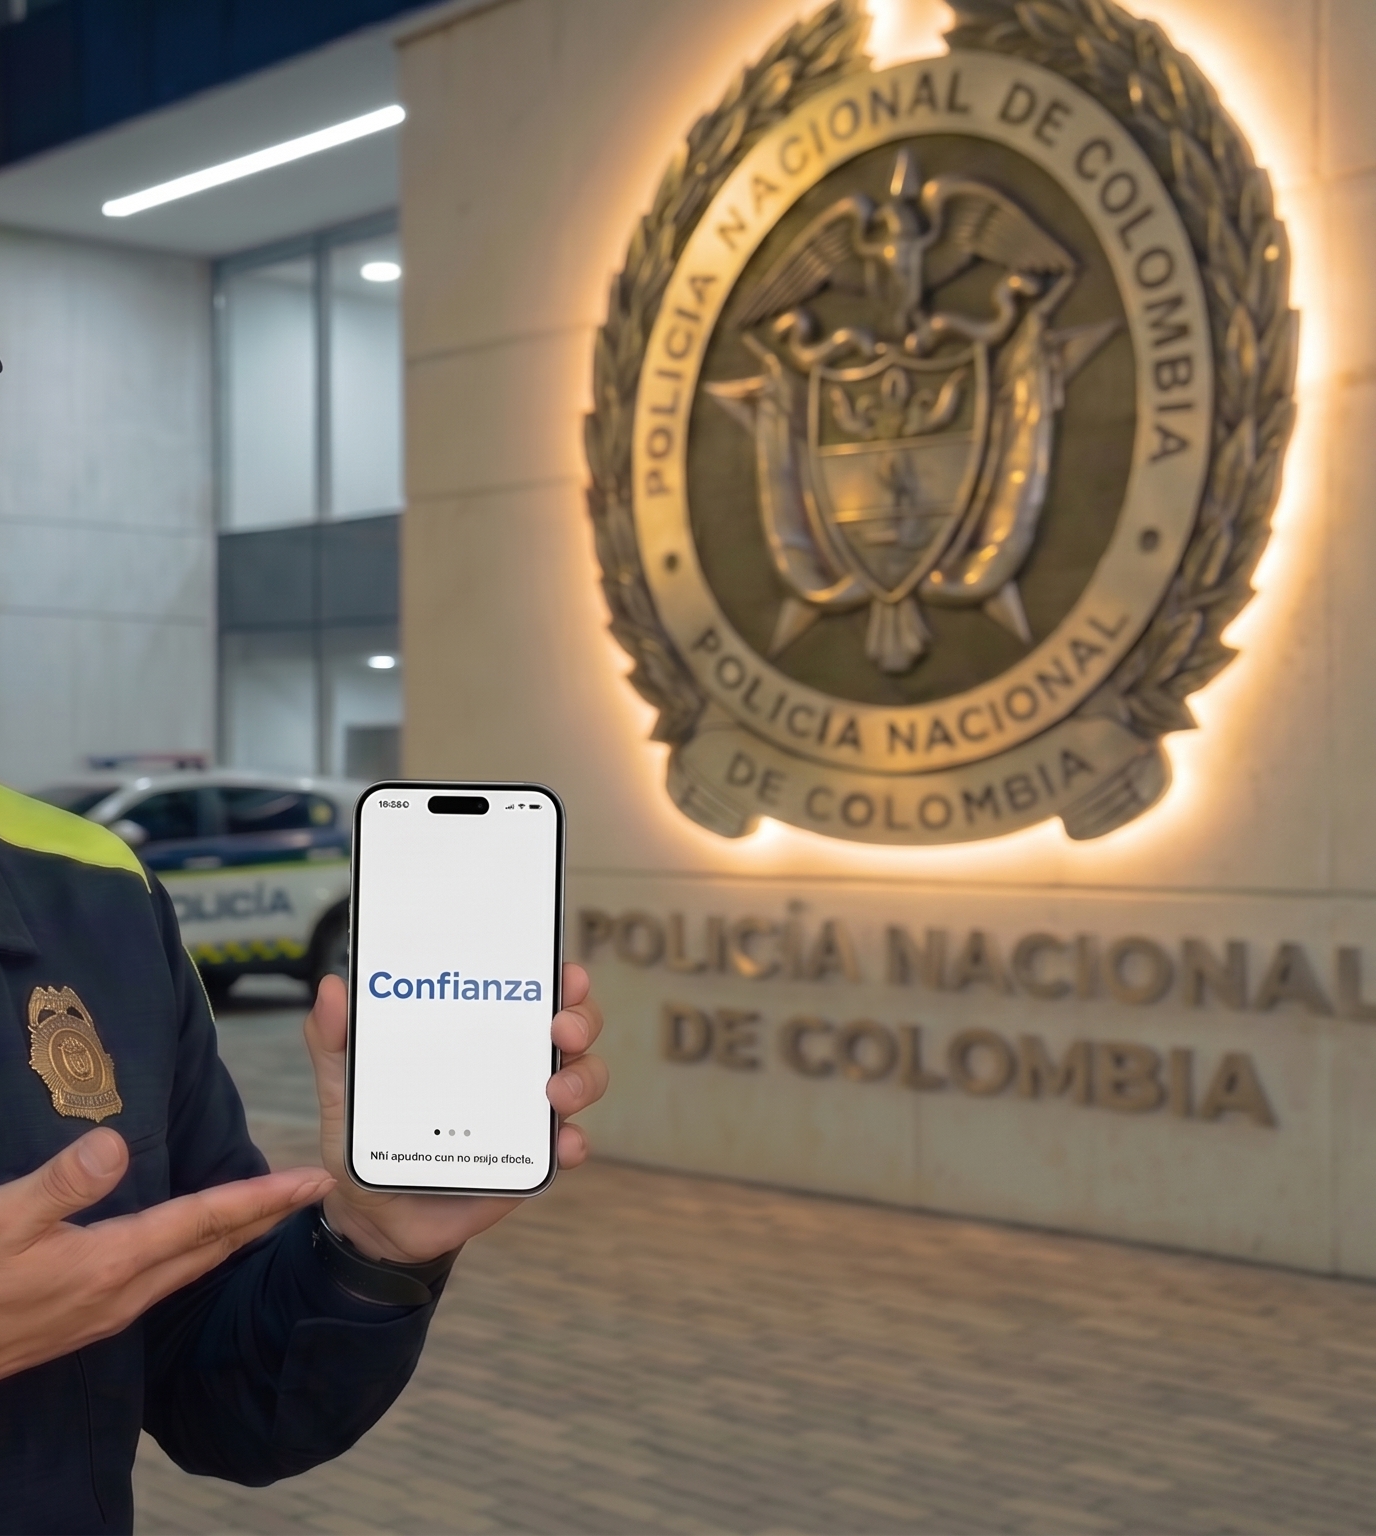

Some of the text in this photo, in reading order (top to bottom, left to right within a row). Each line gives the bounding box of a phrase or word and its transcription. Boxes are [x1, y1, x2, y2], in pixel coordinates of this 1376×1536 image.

[714, 69, 972, 253] NACIONAL
[997, 82, 1073, 149] DE
[1073, 136, 1195, 467] COLOMBIA
[886, 612, 1131, 756] NACIONAL
[725, 748, 1098, 834] DE COLOMBIA
[368, 971, 542, 1002] Confianza
[884, 924, 1376, 1023] NACIONAL
[658, 1001, 1280, 1129] DE COLOMBIA
[391, 1152, 432, 1163] apudno
[434, 1154, 455, 1163] cun
[457, 1154, 471, 1163] no
